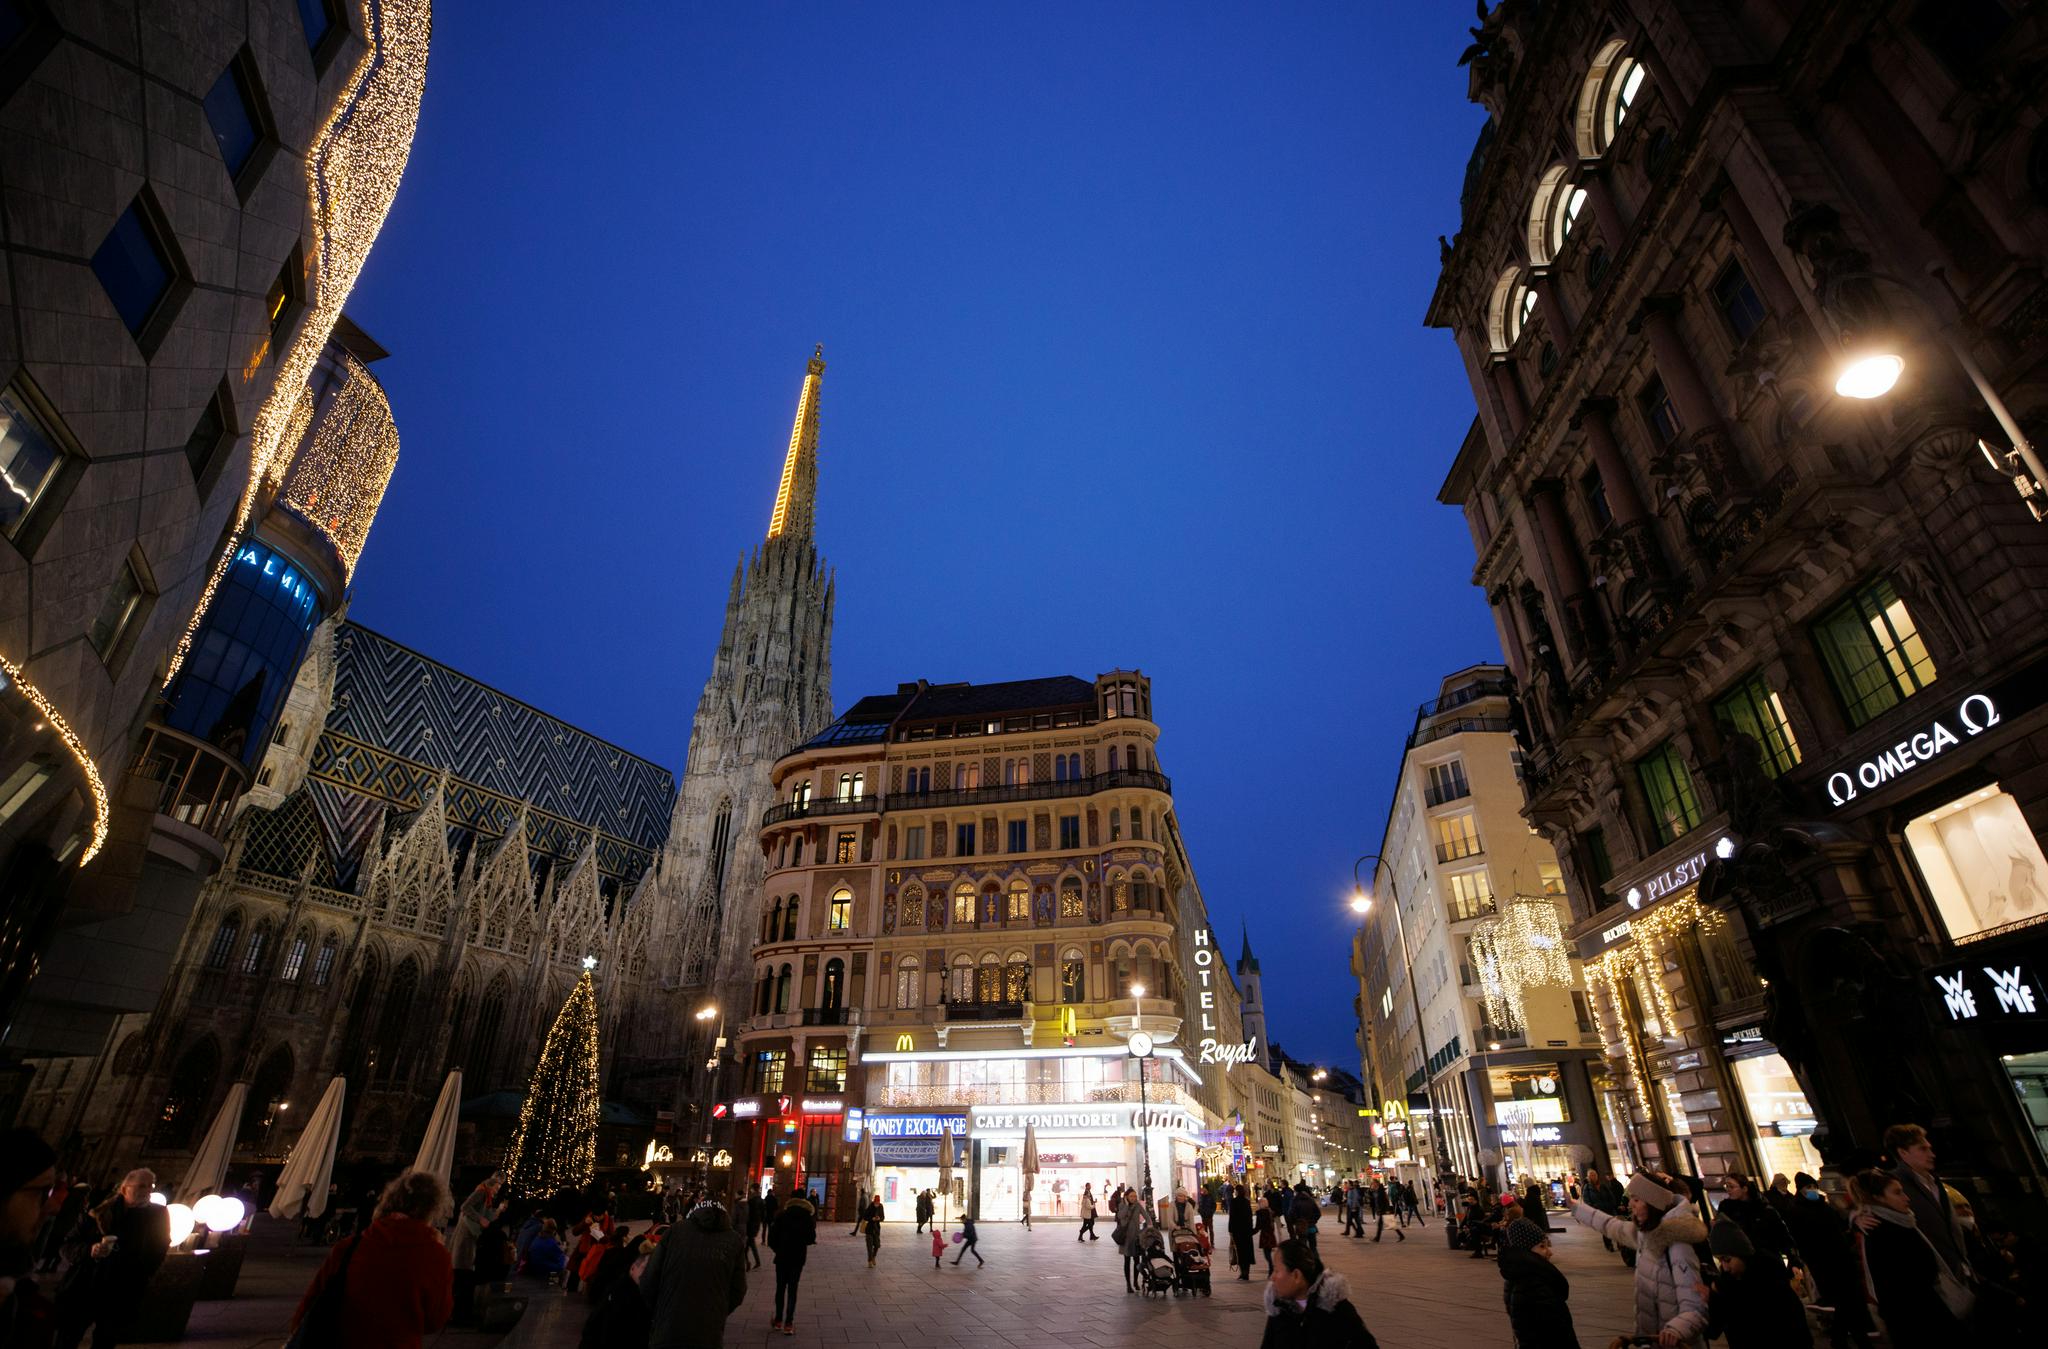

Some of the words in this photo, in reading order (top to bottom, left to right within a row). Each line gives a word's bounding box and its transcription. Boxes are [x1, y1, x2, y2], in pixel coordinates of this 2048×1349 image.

[1859, 721, 1959, 789] OMEGA
[1194, 929, 1216, 1031] HOTEL
[1934, 969, 1978, 1020] WMF
[1982, 966, 2036, 1013] WMF
[1200, 1036, 1257, 1072] Royal
[864, 1118, 905, 1135] MONEY
[905, 1118, 966, 1135] EXCHANGE
[1018, 1113, 1117, 1128] KONDITOREI
